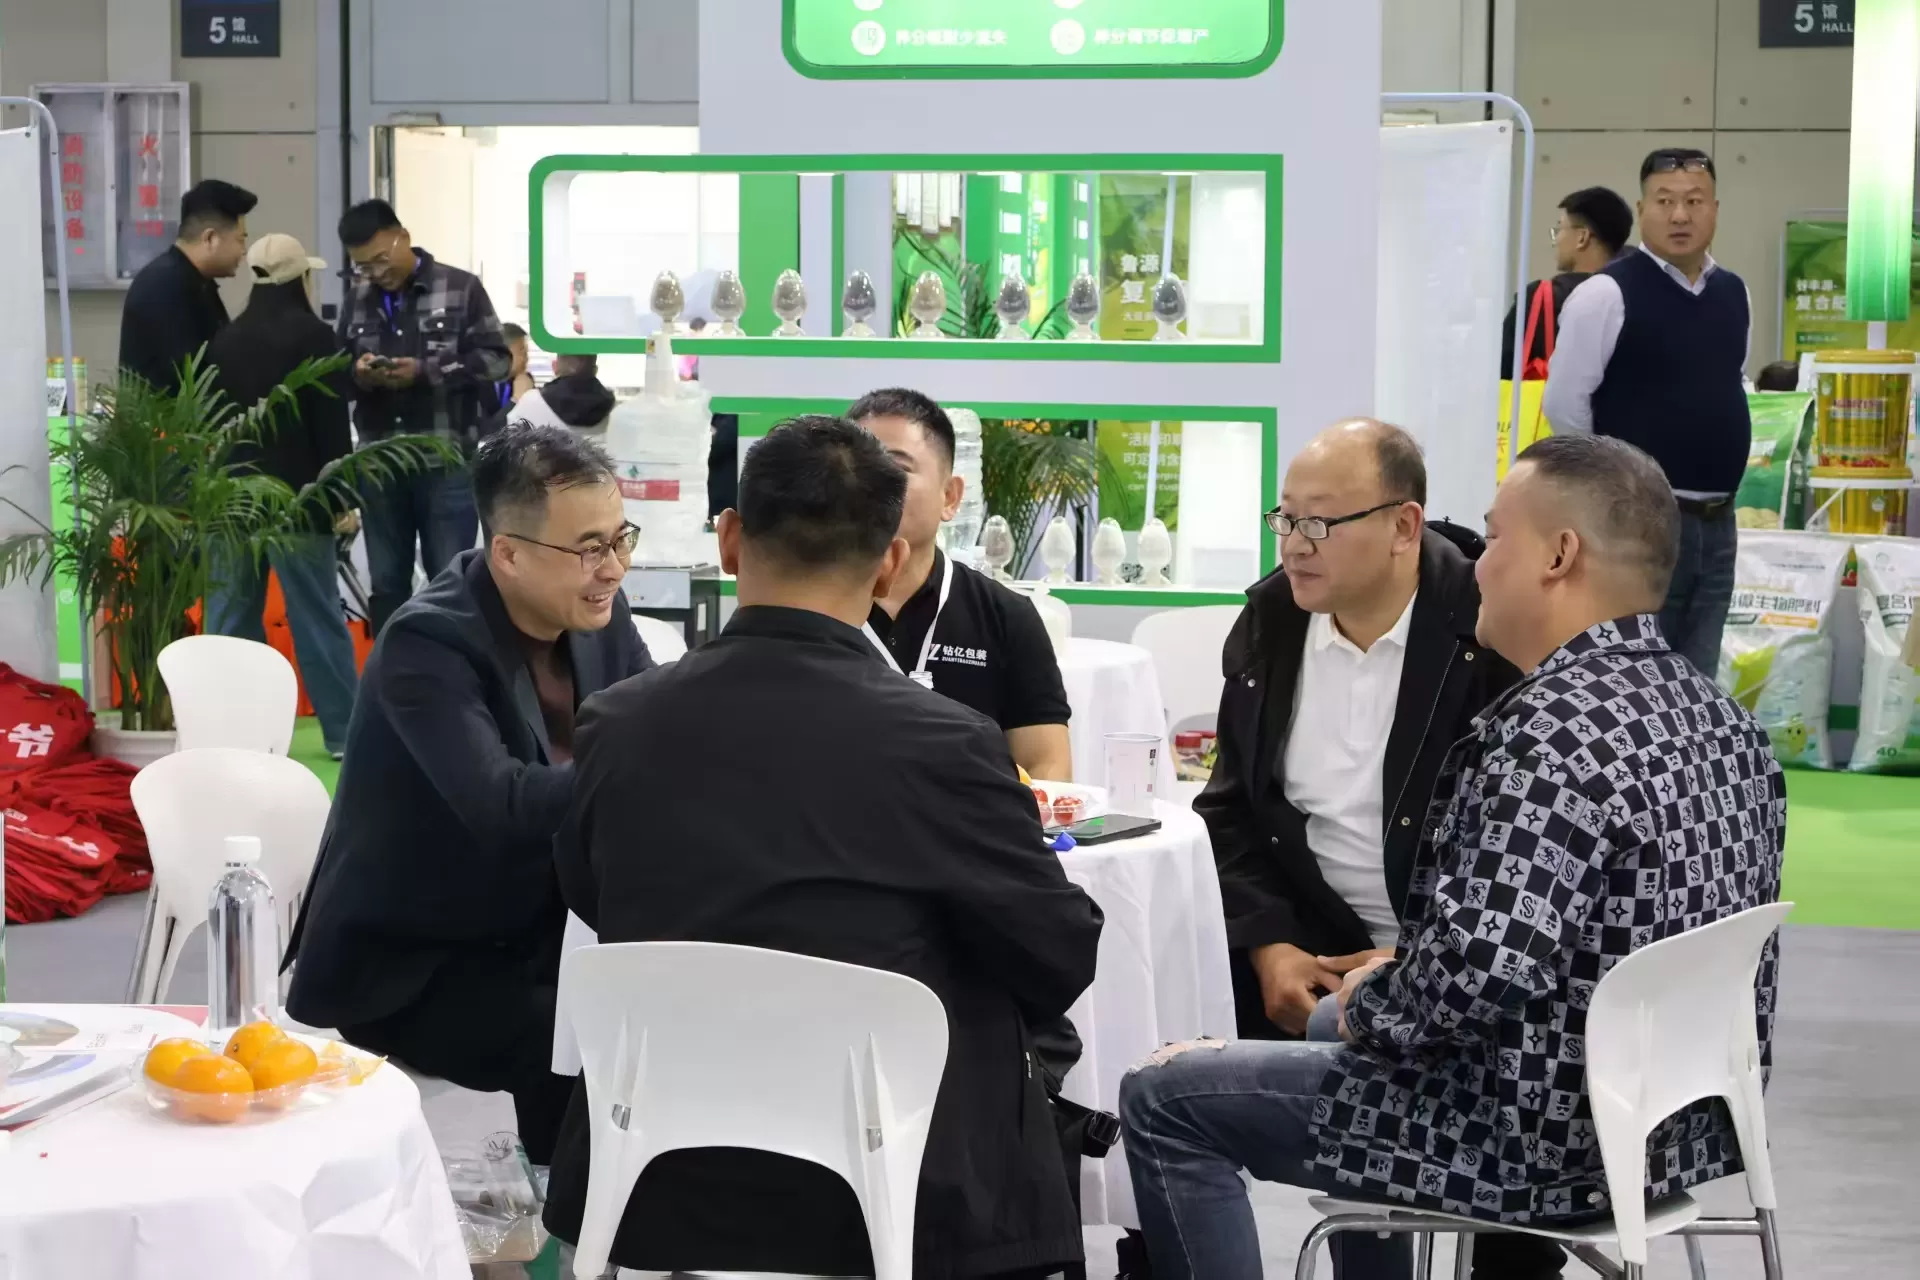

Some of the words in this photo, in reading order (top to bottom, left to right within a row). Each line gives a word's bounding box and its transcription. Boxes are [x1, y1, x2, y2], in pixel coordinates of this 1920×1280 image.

[1794, 3, 1814, 33] 5
[209, 16, 227, 44] 5
[1821, 22, 1854, 33] HALL
[231, 34, 260, 44] HALL
[942, 645, 987, 661] 钻亿包装
